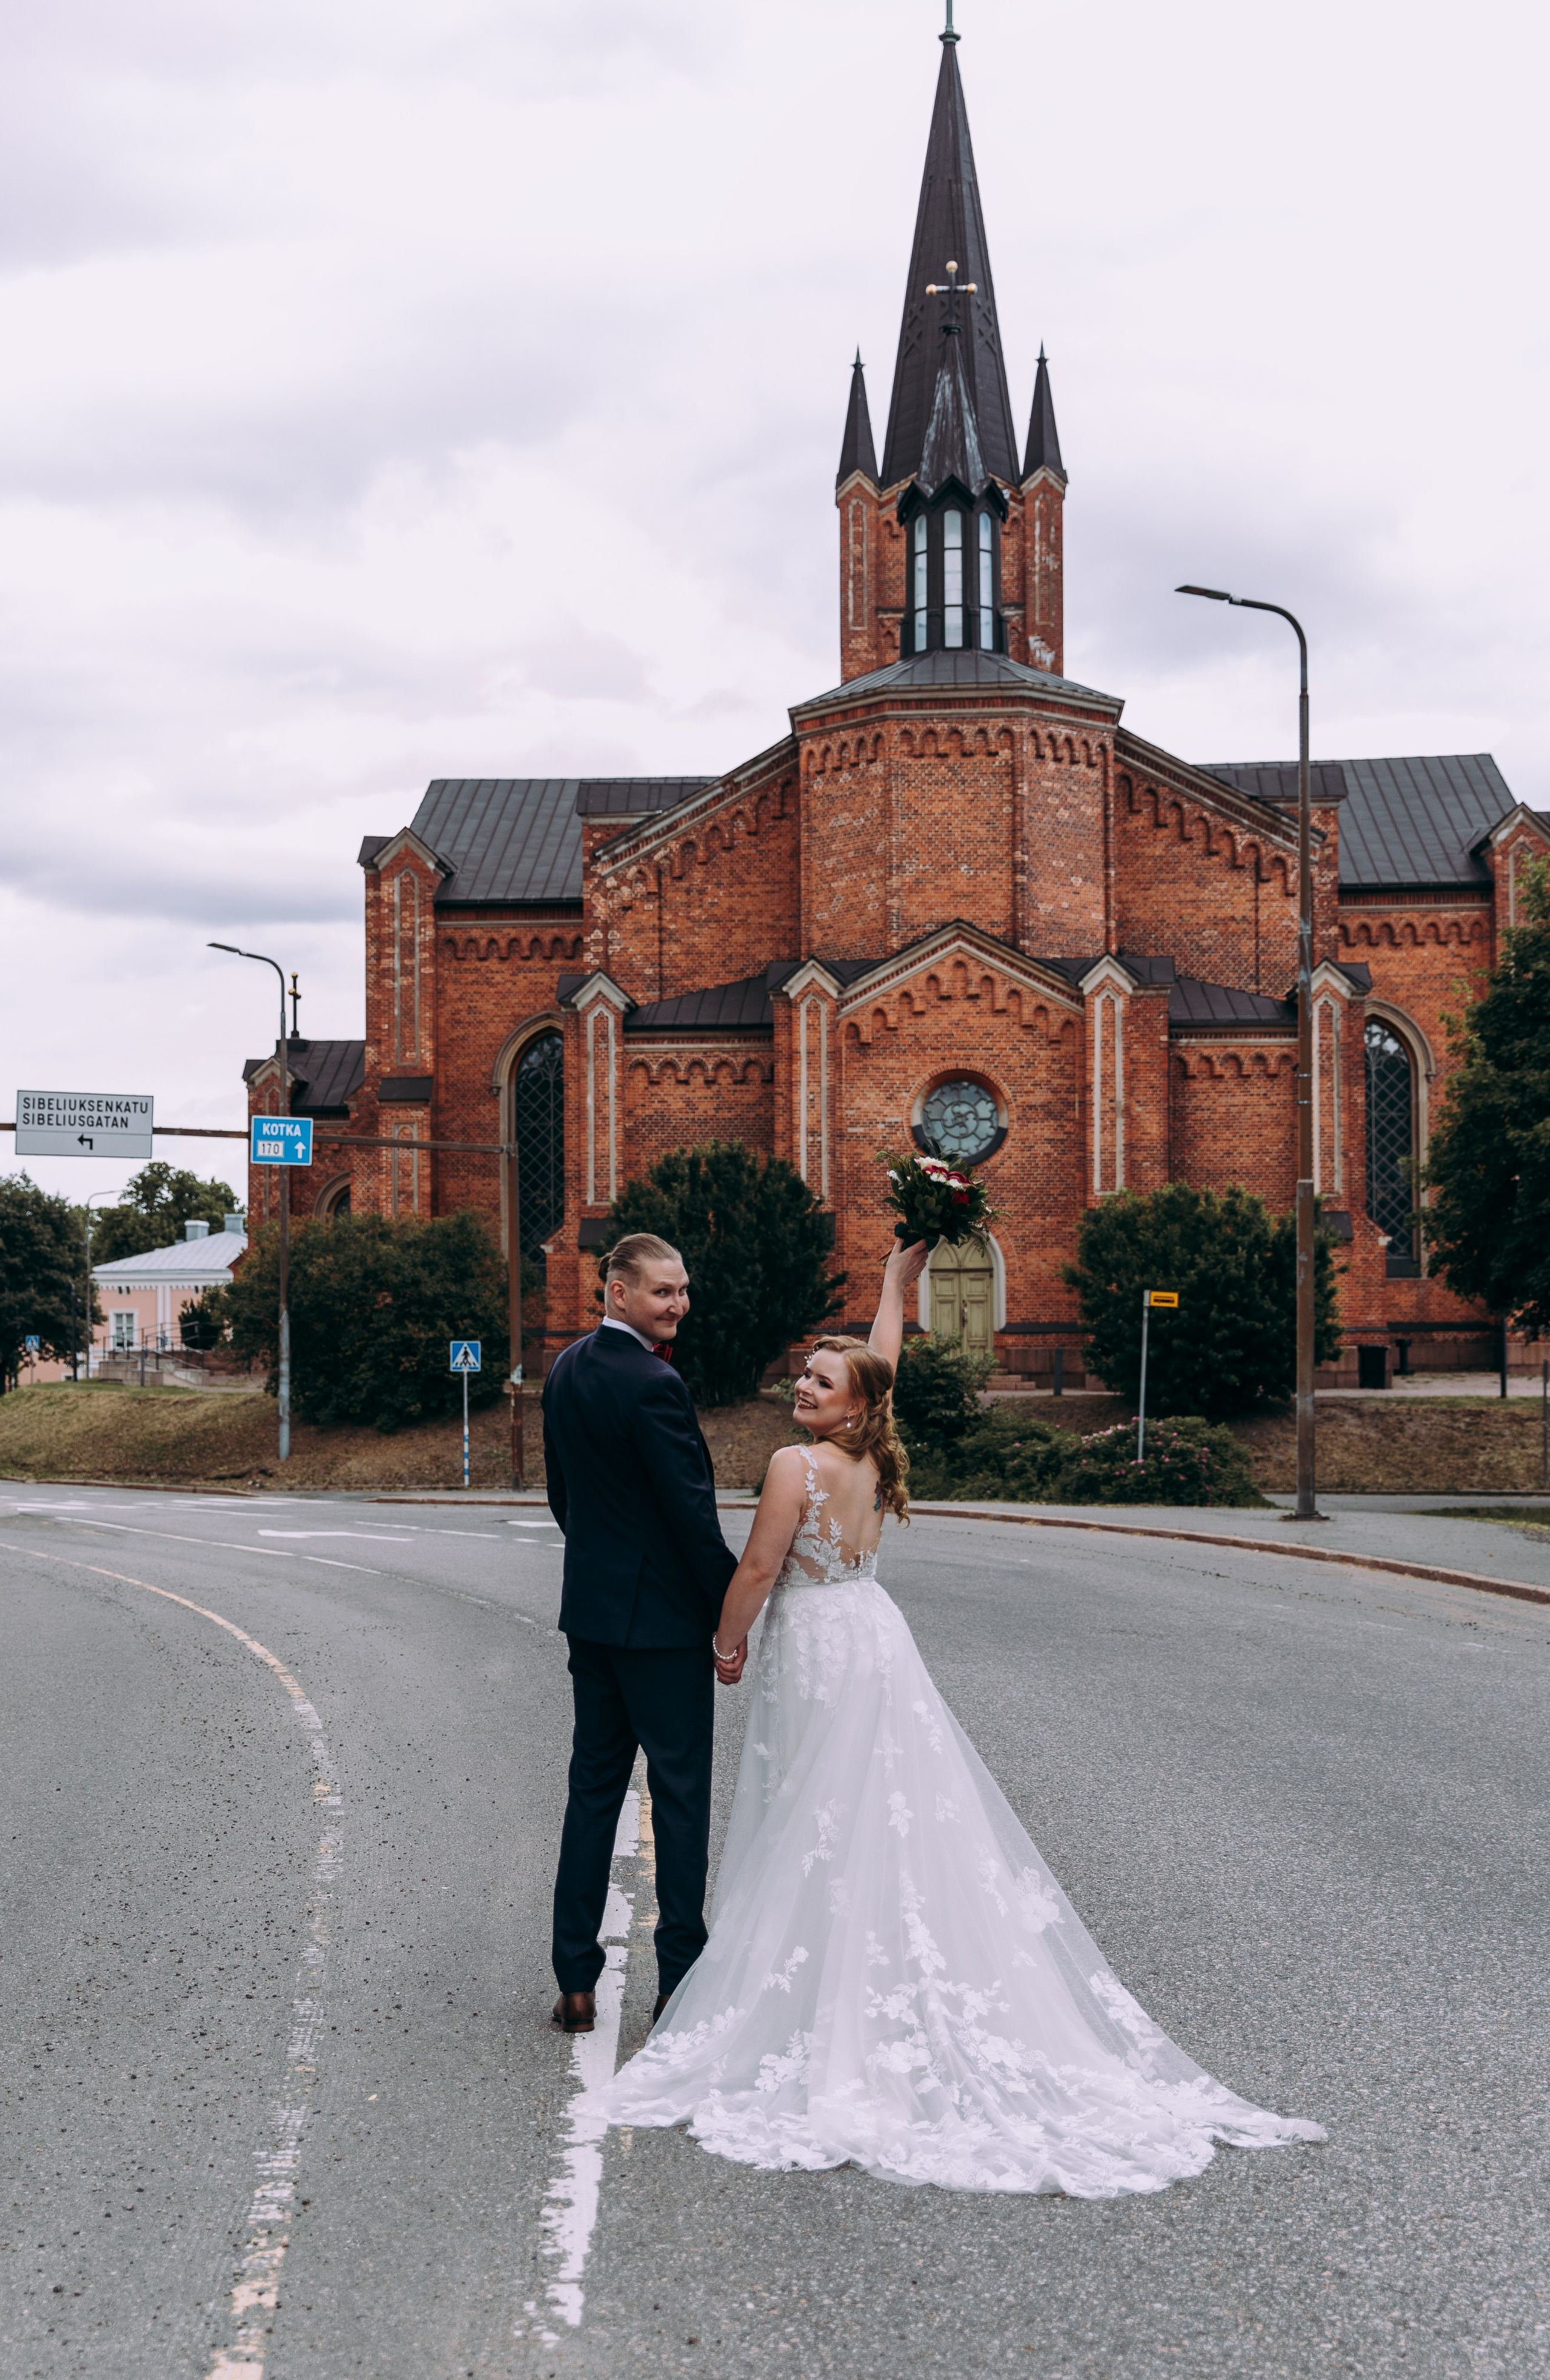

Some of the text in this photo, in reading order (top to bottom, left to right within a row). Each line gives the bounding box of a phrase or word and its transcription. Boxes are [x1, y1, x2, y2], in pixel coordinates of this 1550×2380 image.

[22, 1097, 148, 1114] SIBELIUKSENKATU
[22, 1113, 129, 1128] SIBELIUSGATAN
[262, 1122, 302, 1137] KOTKA
[262, 1143, 280, 1154] 170
